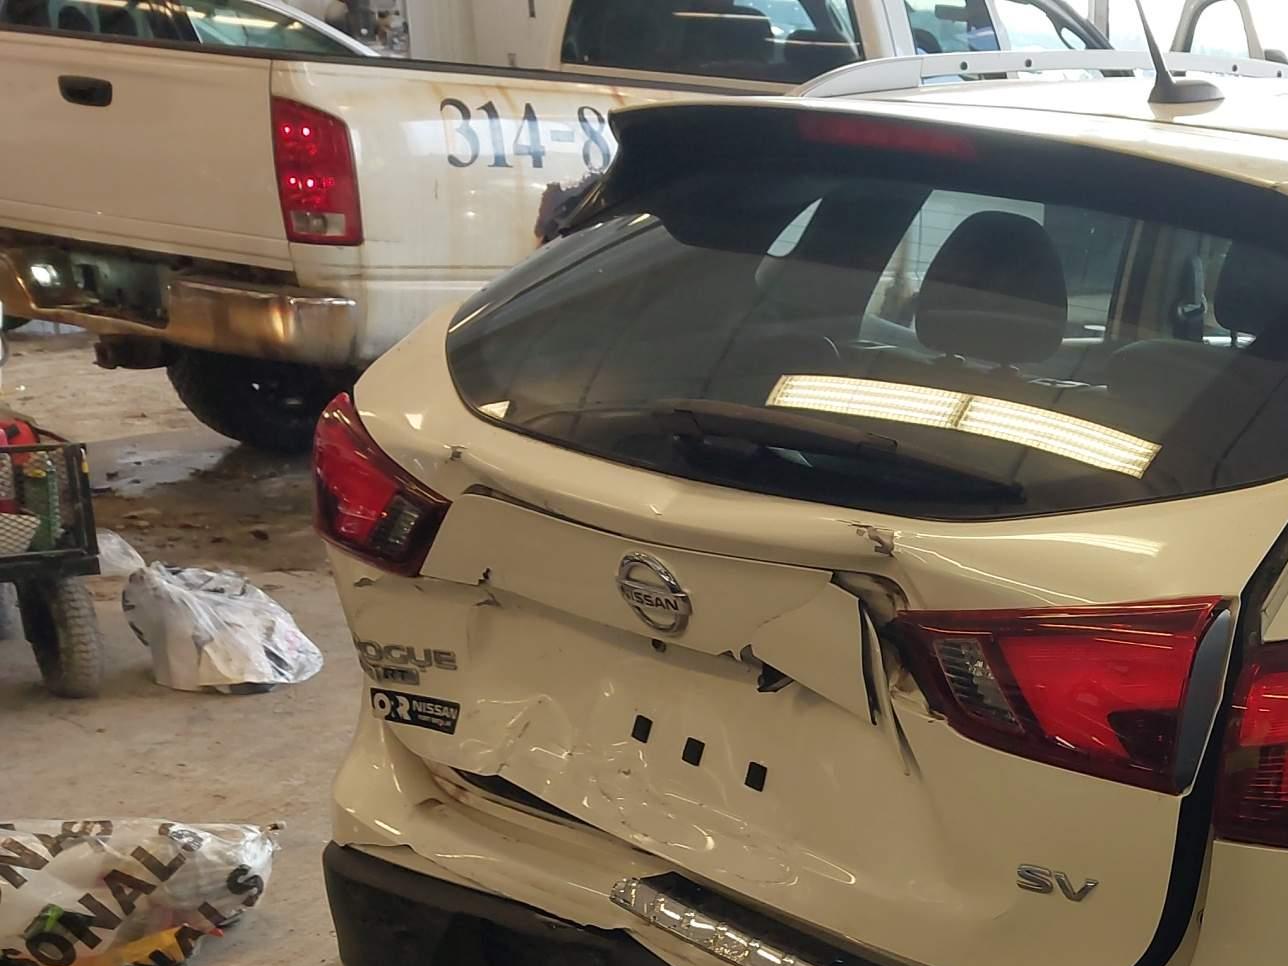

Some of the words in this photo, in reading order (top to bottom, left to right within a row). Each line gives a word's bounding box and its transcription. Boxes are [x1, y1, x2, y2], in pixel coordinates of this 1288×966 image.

[439, 98, 611, 169] 314-8
[622, 589, 679, 611] NISSAN
[353, 634, 458, 671] OGUE
[412, 700, 458, 720] NISSAN
[1016, 863, 1100, 903] SV
